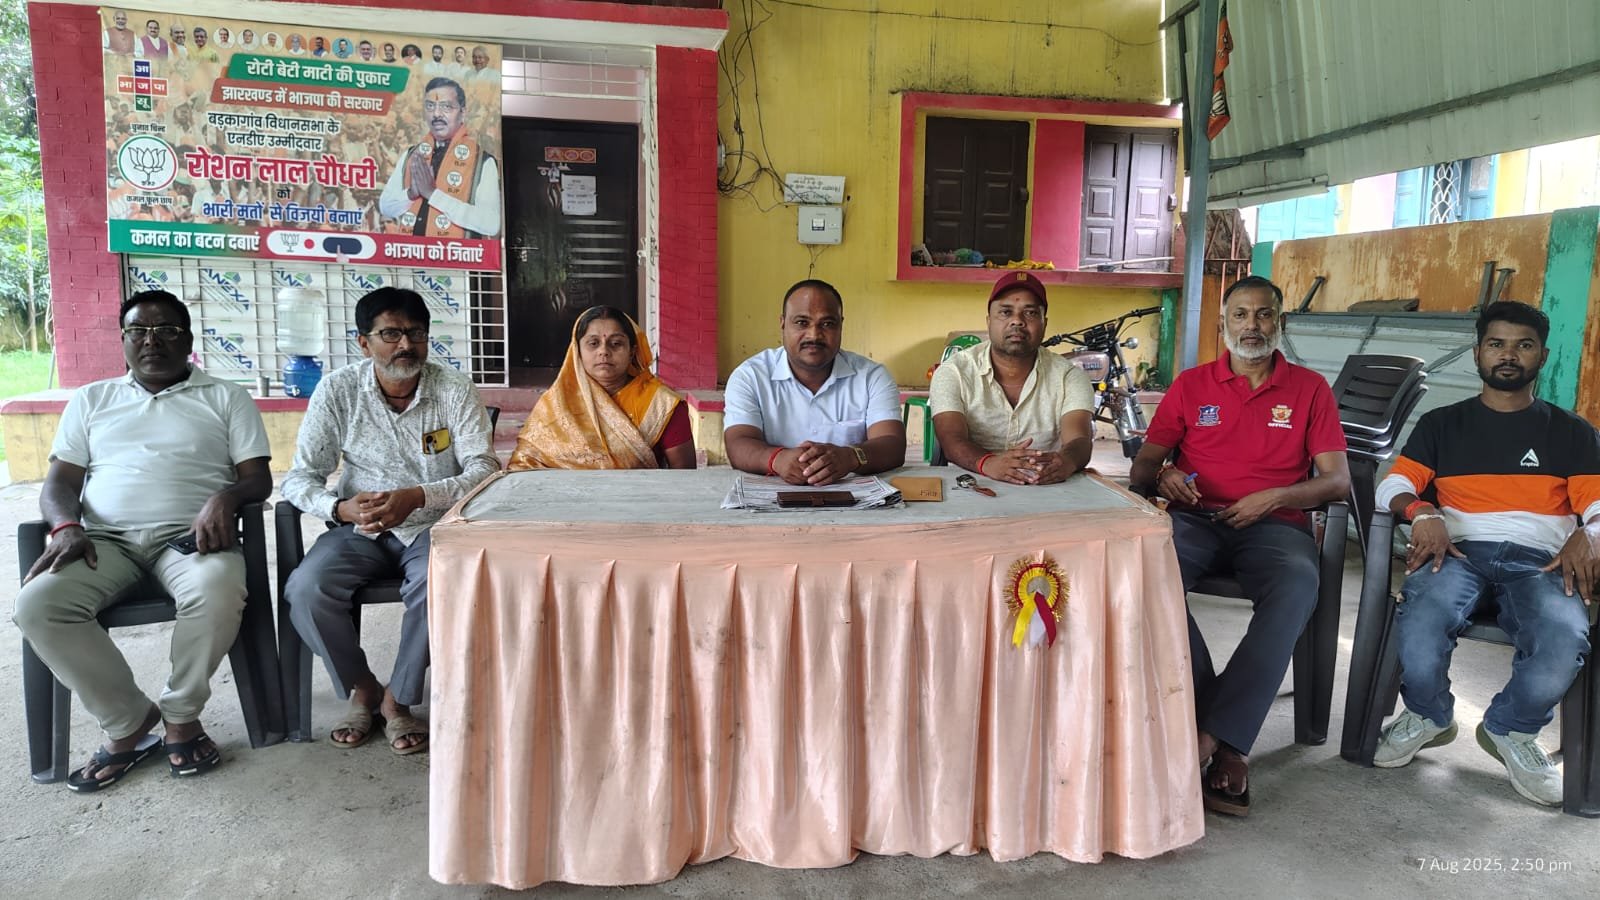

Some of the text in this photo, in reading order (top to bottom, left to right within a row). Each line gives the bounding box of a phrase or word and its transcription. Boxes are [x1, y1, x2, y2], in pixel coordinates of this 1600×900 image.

[245, 58, 391, 88] रोटी बेटी माटी की पुकार
[221, 86, 383, 111] झारखण्ड में भाजपा की सरकार
[208, 112, 340, 134] बड़कागांव विधानसभा के
[227, 130, 322, 150] एनडीए उम्मीदवार
[186, 147, 377, 188] रोशन लाल चौधरी
[276, 186, 291, 200] को
[202, 200, 364, 226] भारी मतों से विजयी बनाएं
[130, 229, 260, 251] कमल का बटन दबाएं
[384, 240, 485, 263] भाजपा को जिताएं
